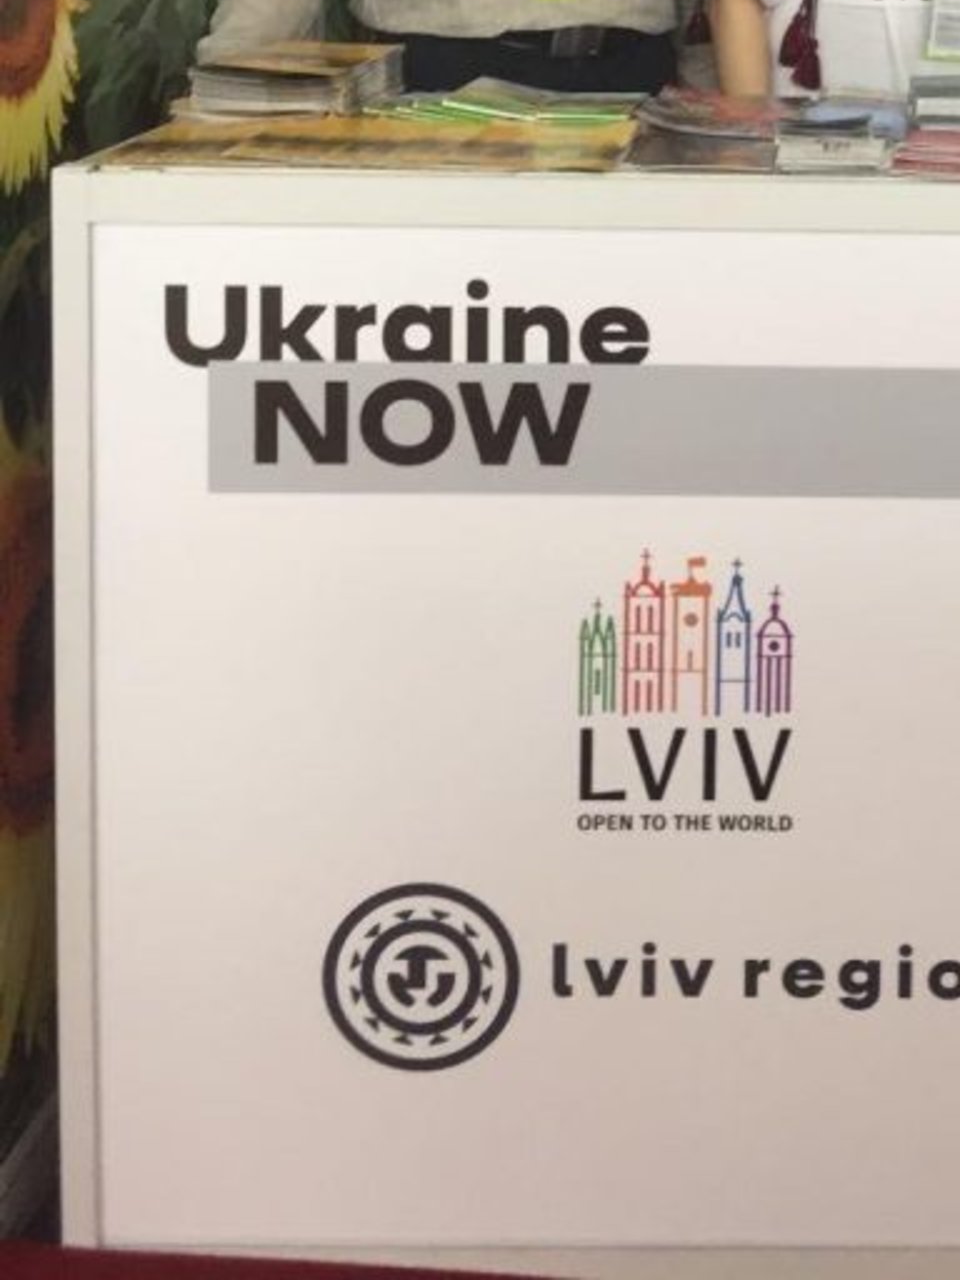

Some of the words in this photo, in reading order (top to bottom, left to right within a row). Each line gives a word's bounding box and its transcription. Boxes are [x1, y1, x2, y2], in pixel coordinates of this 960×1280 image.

[165, 278, 651, 367] Ukraine
[254, 379, 592, 467] NOW
[579, 727, 793, 802] LVIV
[577, 814, 634, 832] OPEN
[640, 814, 667, 832] TO
[673, 814, 712, 832] THE
[718, 814, 793, 832] WORLD
[552, 942, 714, 998] lviv
